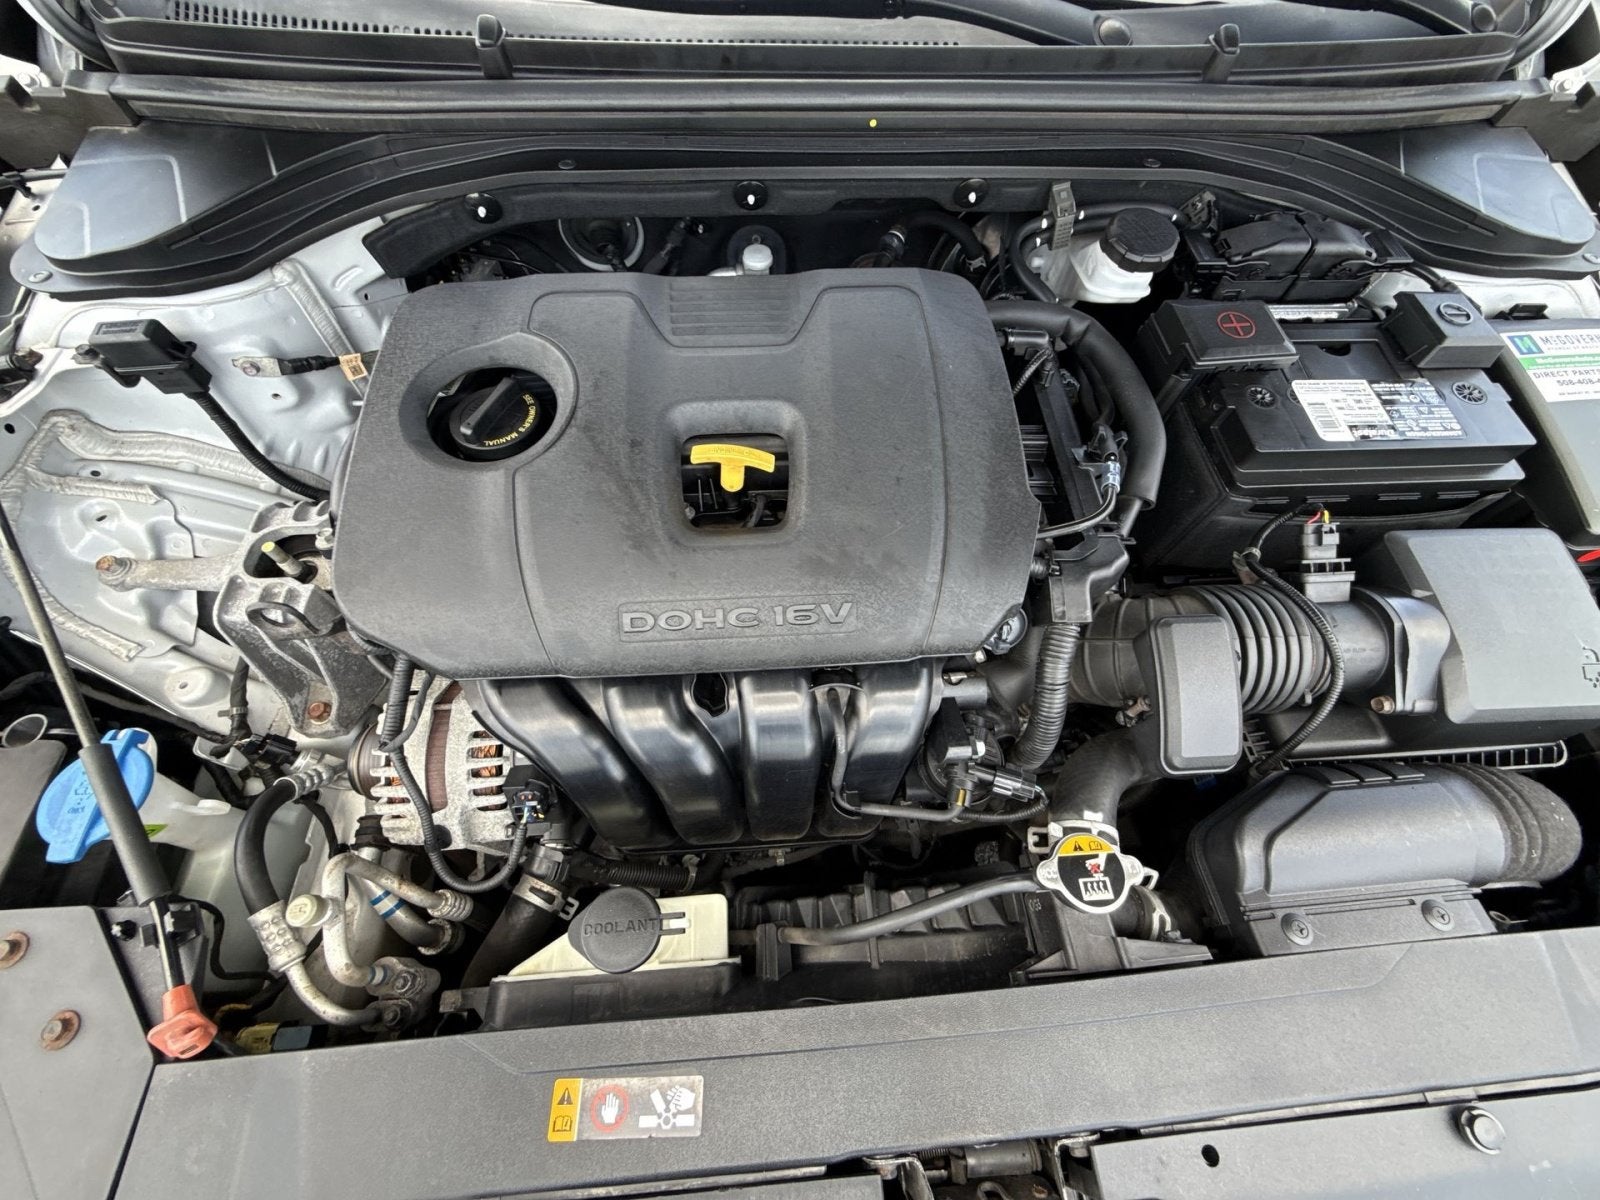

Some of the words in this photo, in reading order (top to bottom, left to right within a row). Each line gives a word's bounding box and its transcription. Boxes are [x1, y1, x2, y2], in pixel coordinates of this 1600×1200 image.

[1532, 370, 1569, 379] DIRECT
[522, 393, 535, 405] SEE
[518, 405, 537, 432] OWNER'S
[483, 431, 518, 446] MANUAL
[1353, 428, 1396, 438] Duralast
[622, 607, 760, 633] DOHC
[773, 602, 853, 626] 16V
[583, 917, 659, 937] COOLANT
